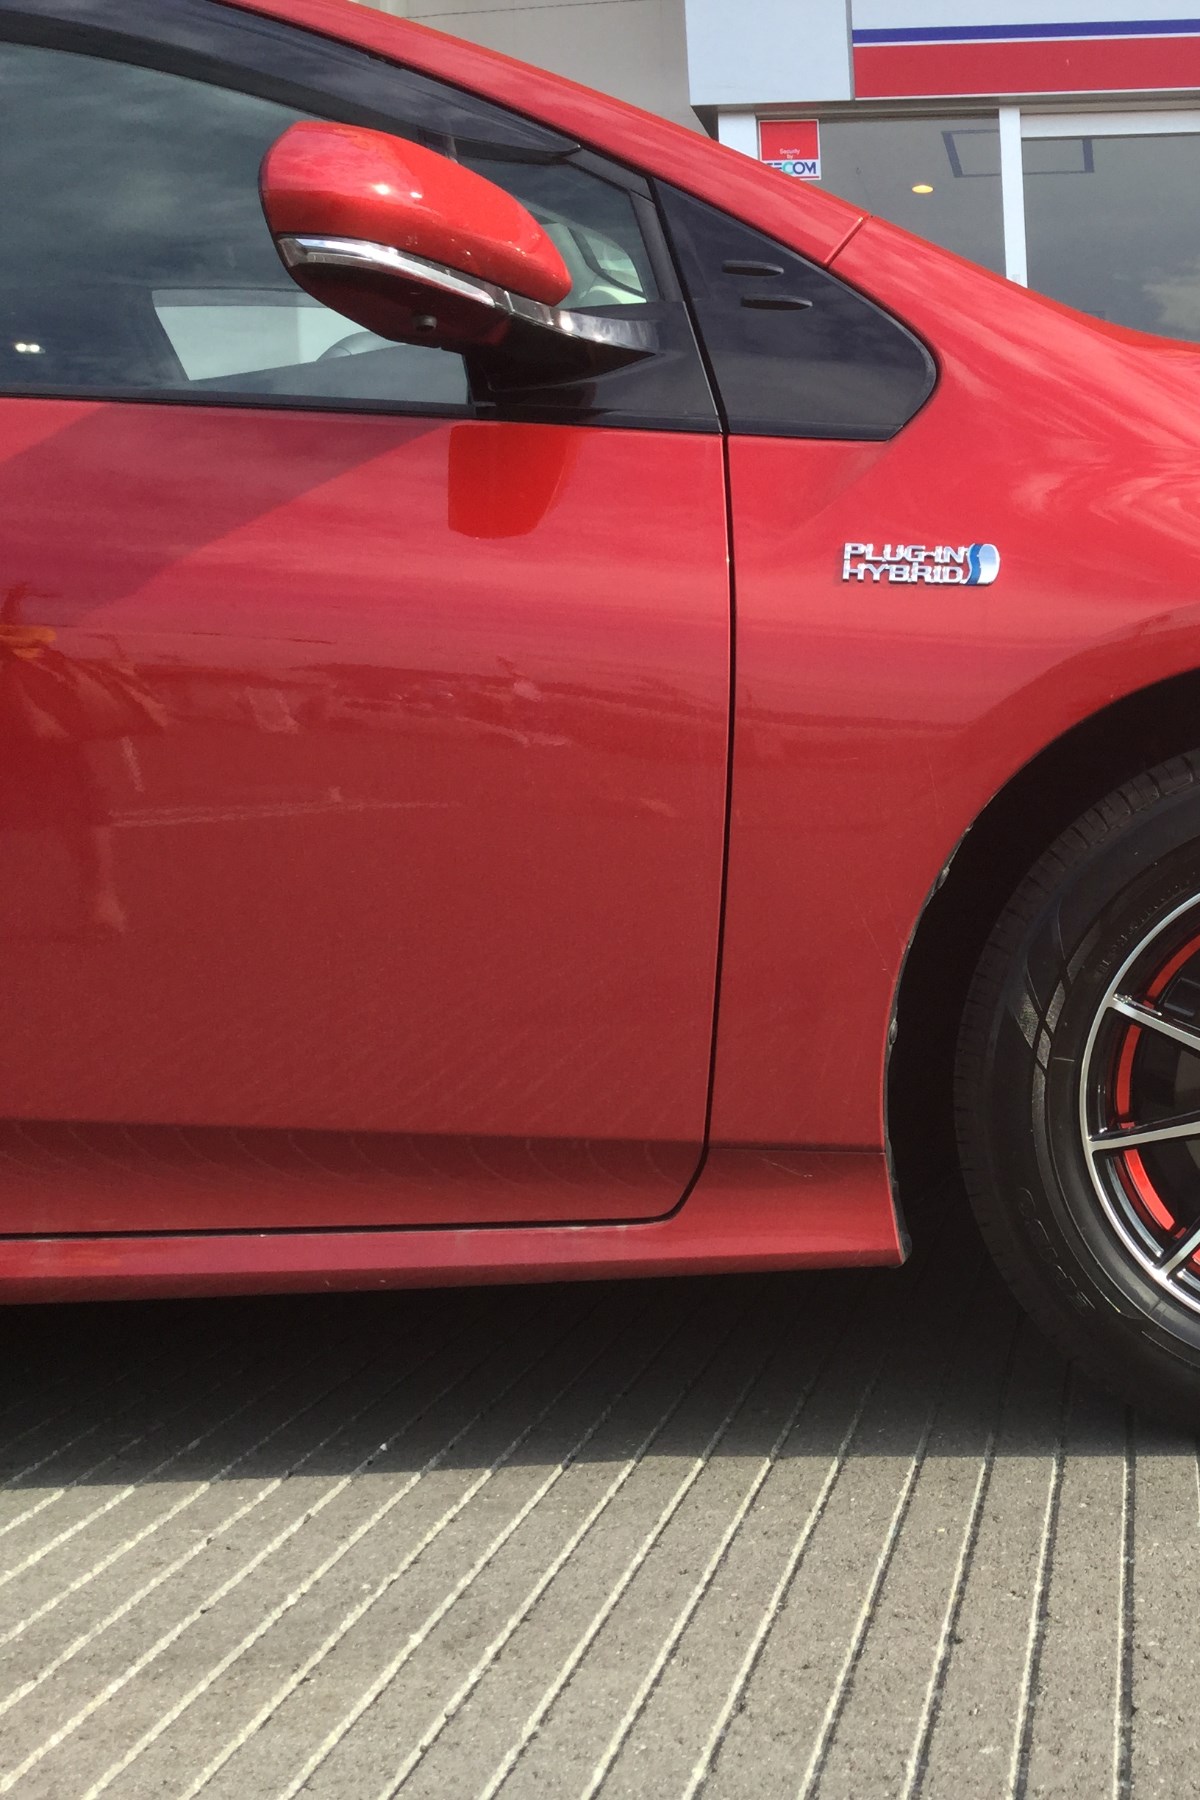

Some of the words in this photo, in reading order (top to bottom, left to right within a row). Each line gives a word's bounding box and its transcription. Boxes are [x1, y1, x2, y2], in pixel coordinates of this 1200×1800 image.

[766, 161, 817, 175] ECOM
[843, 542, 968, 564] PLUG-IN
[842, 559, 965, 584] HYBRID
